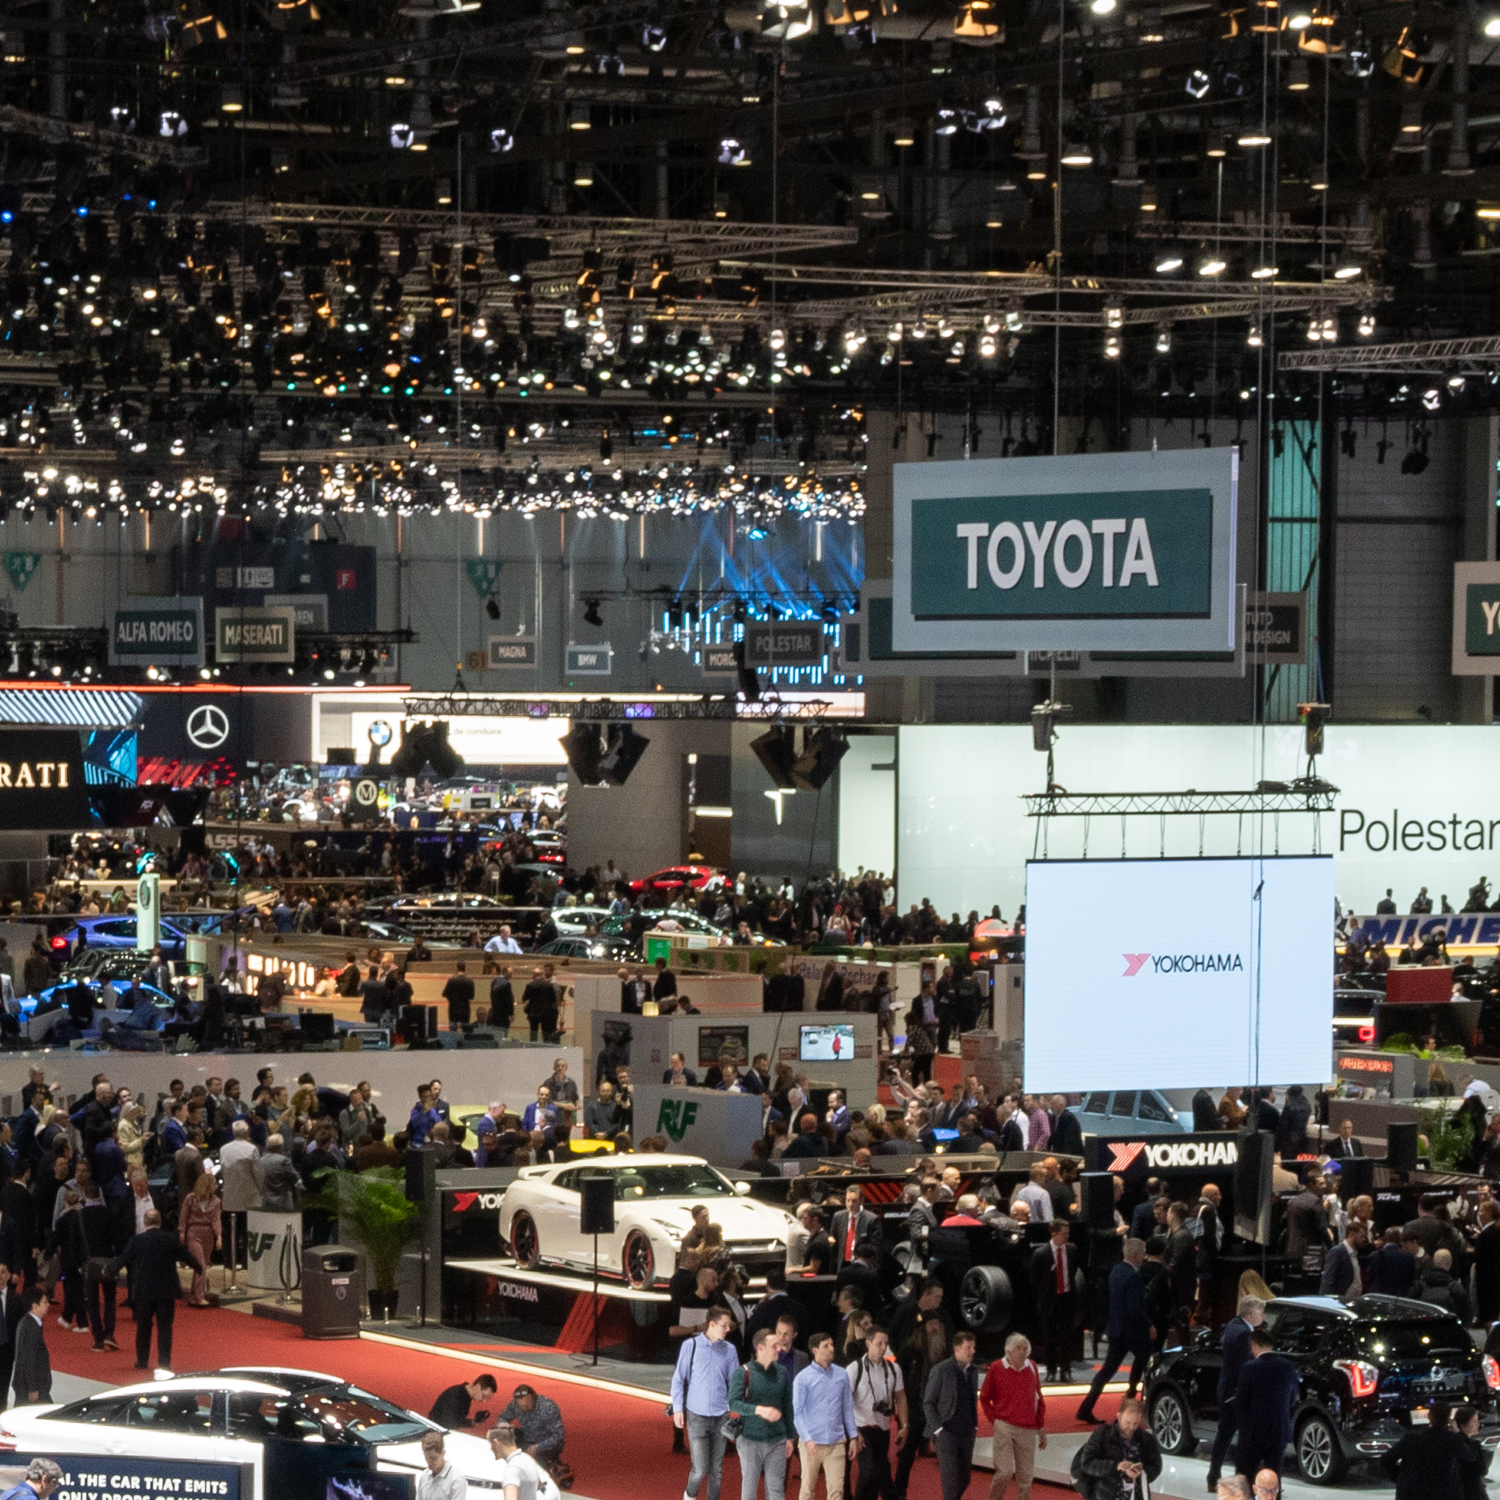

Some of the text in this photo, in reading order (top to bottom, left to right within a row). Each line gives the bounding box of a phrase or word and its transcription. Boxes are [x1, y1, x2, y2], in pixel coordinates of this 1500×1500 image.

[956, 517, 1159, 590] TOYOTA
[117, 619, 194, 643] ALFA ROMEO
[225, 623, 283, 646] MASERATI
[1253, 630, 1291, 644] DESIGN
[497, 646, 527, 659] MAGNA
[755, 634, 813, 653] POLESTAR
[577, 653, 598, 667] BMW
[1151, 953, 1244, 973] YOKOHAMA
[655, 1098, 699, 1143] RUF
[497, 1280, 539, 1303] YOKOHAMA
[78, 1473, 107, 1488] THE
[110, 1475, 141, 1490] CAR
[144, 1477, 181, 1492] THAT
[184, 1479, 228, 1495] EMITS
